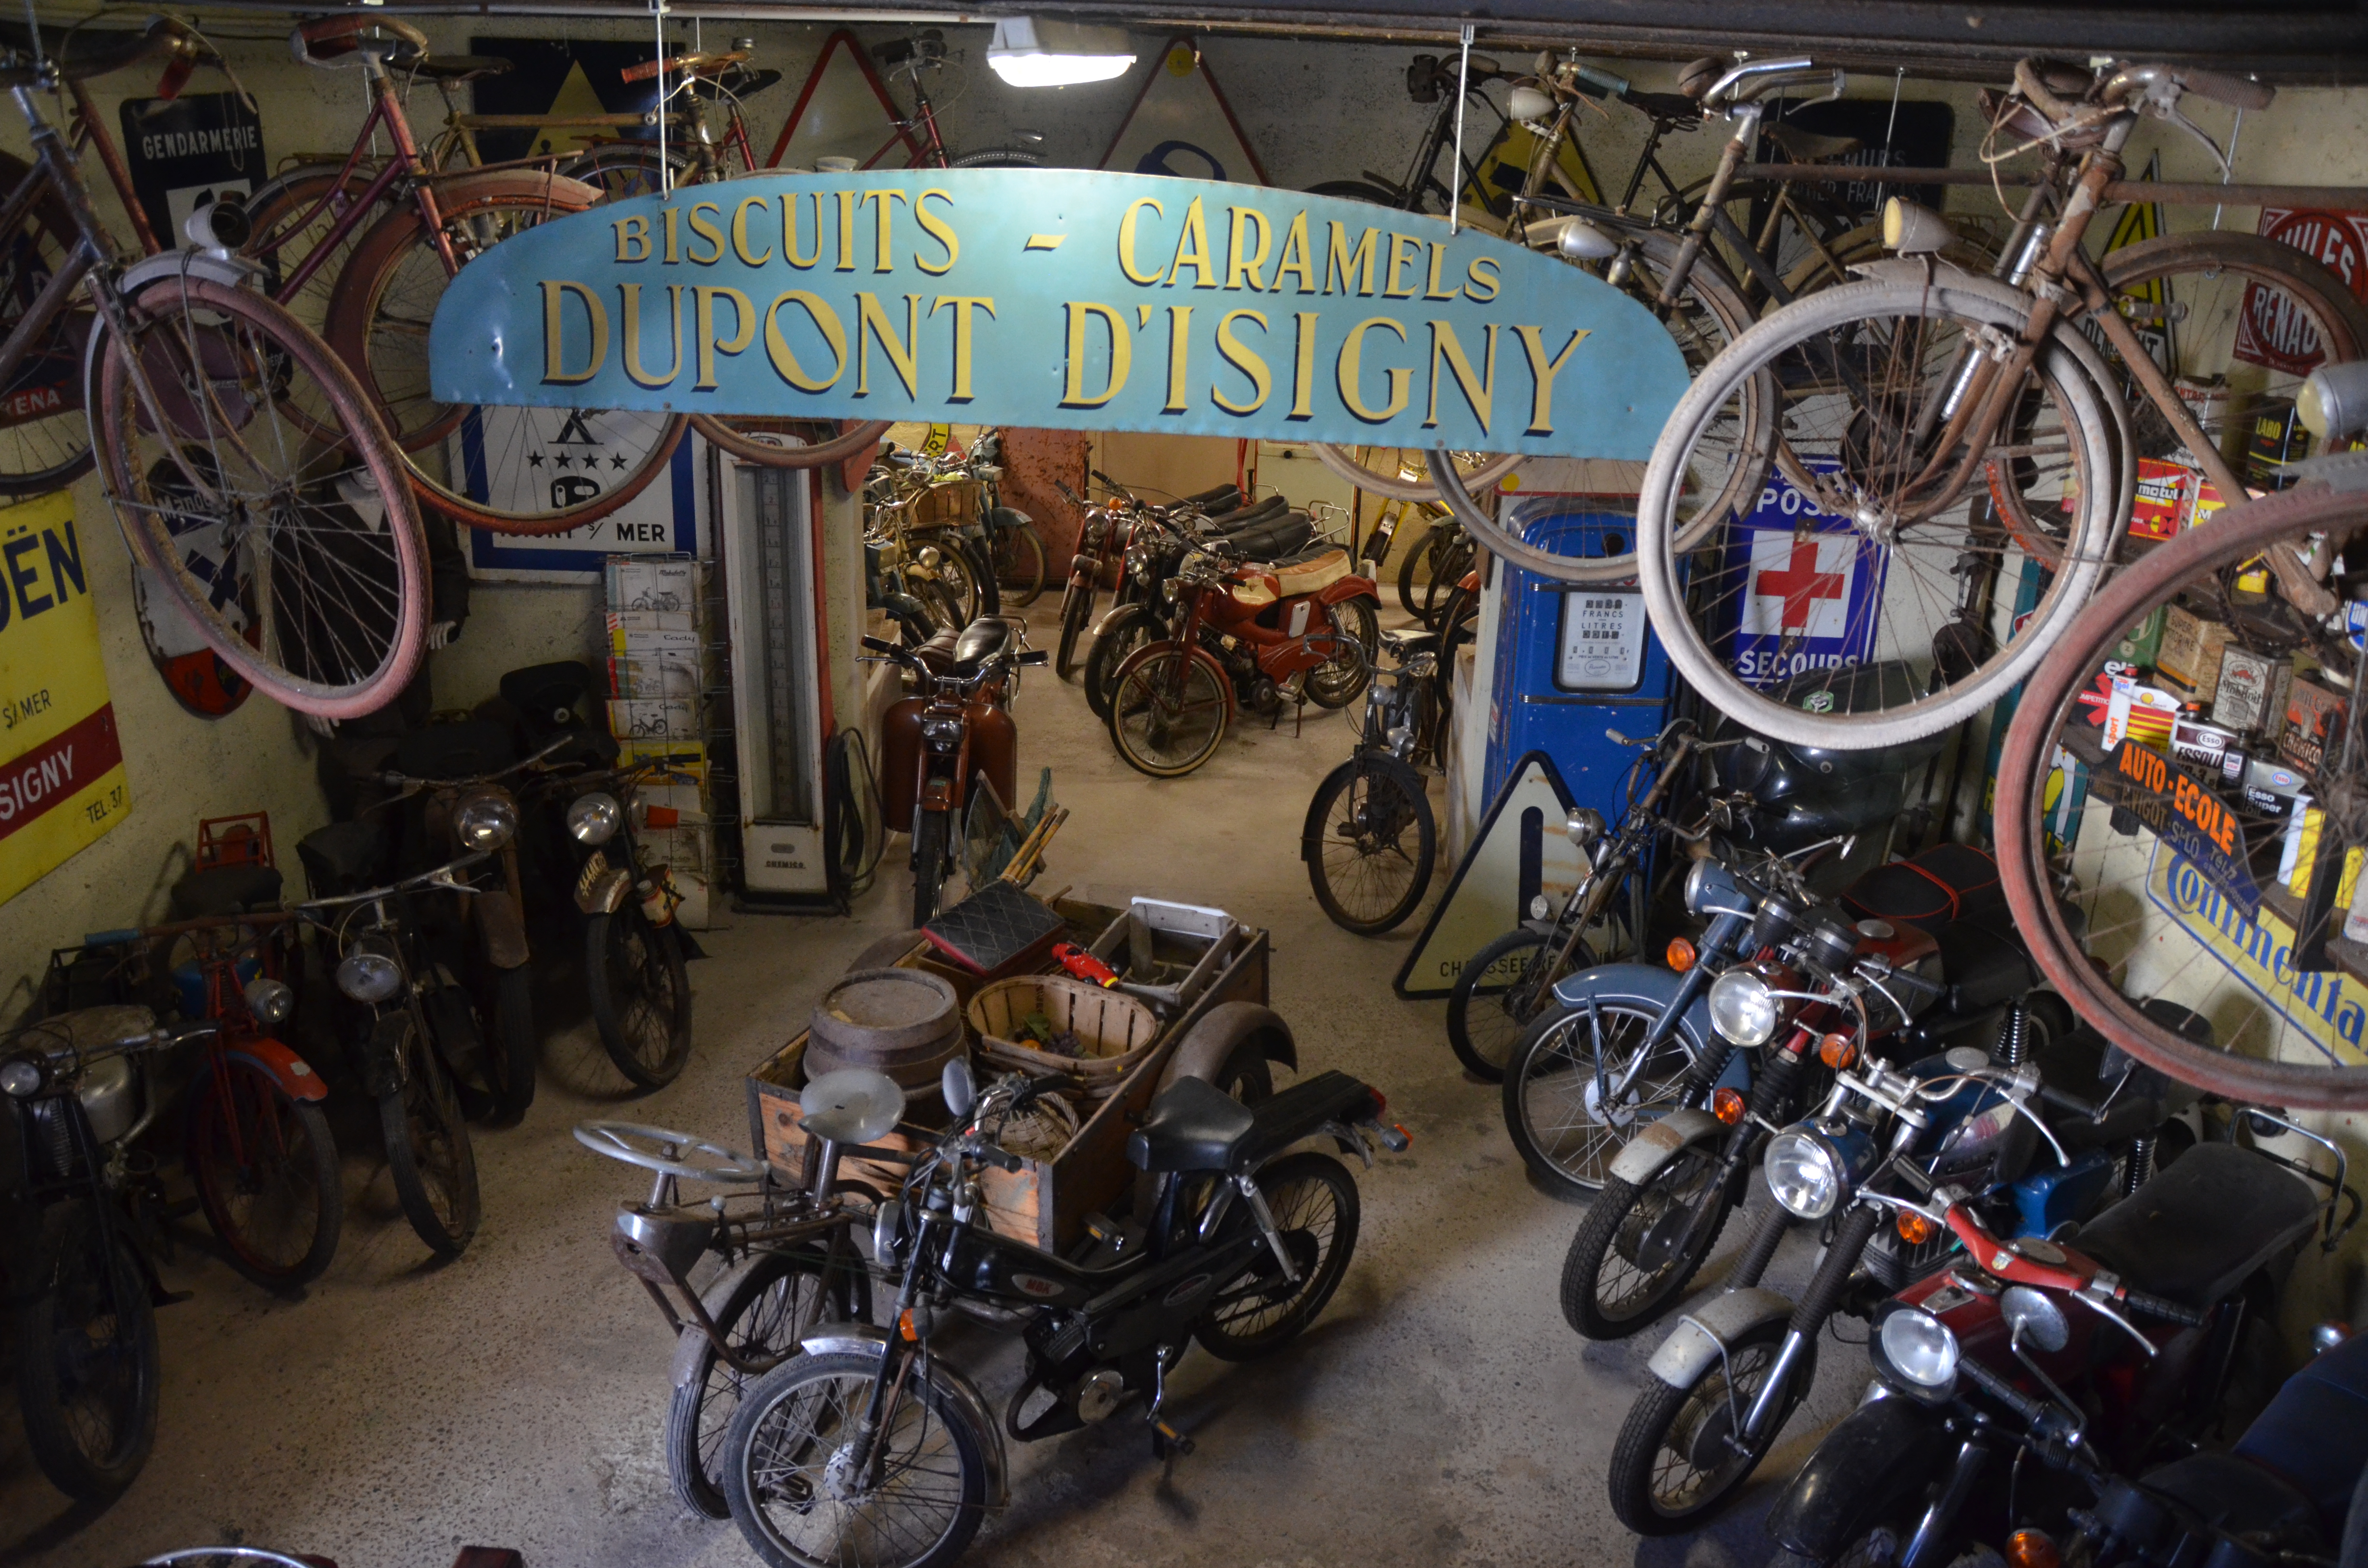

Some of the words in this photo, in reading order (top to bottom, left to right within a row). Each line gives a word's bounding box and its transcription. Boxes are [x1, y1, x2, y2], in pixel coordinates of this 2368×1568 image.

[142, 125, 258, 160] GENDARMERIE
[611, 186, 960, 277] BISCUITS
[1117, 195, 1502, 304] CARAMELS
[2276, 221, 2356, 286] UILES
[2253, 285, 2319, 356] RENAU
[536, 280, 996, 405] DUPONT
[1057, 301, 1593, 437] D'ISIGNY
[2256, 416, 2282, 440] LABO
[1756, 487, 1862, 517] POS
[2138, 485, 2178, 500] motul
[617, 523, 666, 542] MER
[1583, 610, 1623, 618] FRANCS
[664, 634, 695, 643] Cady
[1738, 650, 1860, 675] SECOURS
[2104, 660, 2135, 675] el
[658, 703, 688, 713] Cady
[2108, 717, 2120, 745] sport
[2202, 735, 2220, 745] Esso
[2176, 746, 2224, 770] ESSOLU
[2283, 732, 2323, 764] CHEMICO
[2274, 773, 2289, 784] Esso
[2247, 796, 2282, 813] Super
[2248, 787, 2276, 803] Esso
[2166, 852, 2368, 1058] Continenta
[1025, 1278, 1052, 1295] MBK
